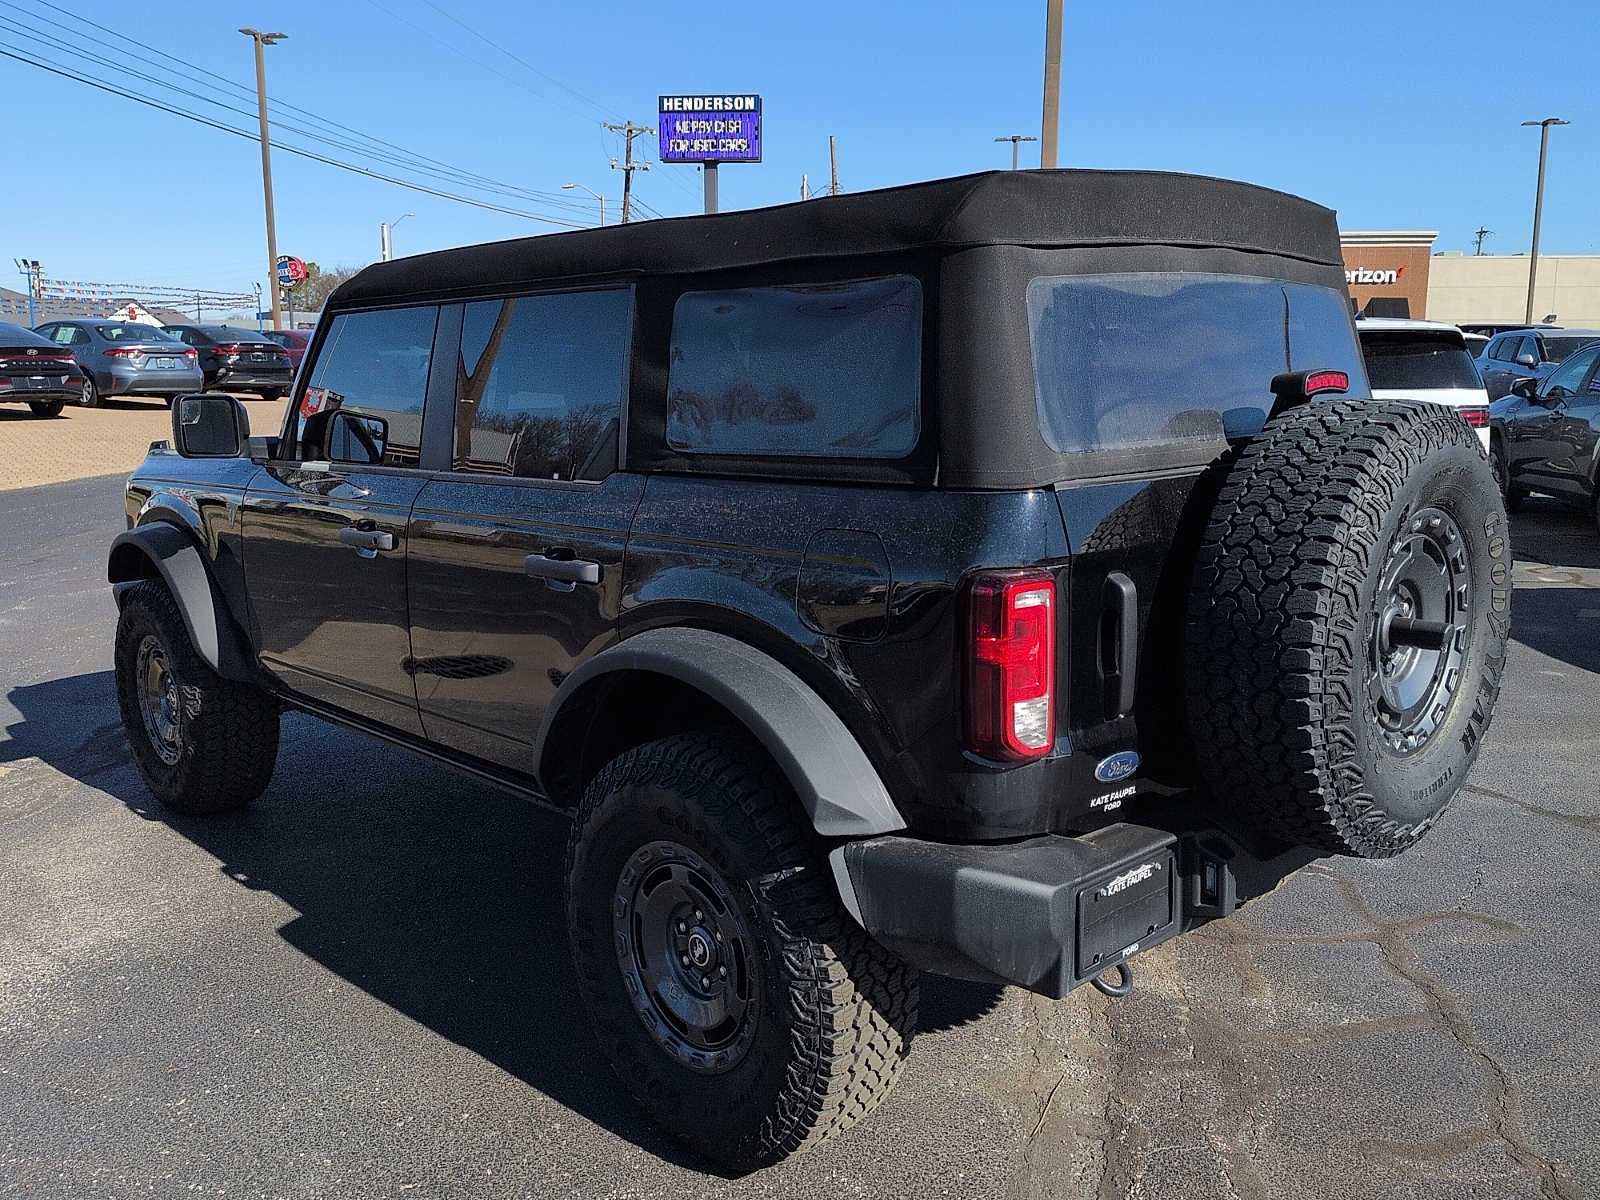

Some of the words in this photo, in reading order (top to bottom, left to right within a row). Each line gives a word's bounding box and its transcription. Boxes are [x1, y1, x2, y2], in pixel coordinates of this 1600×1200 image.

[663, 96, 755, 111] HENDERSON
[691, 120, 712, 133] PAY
[669, 139, 688, 152] FOR
[1090, 794, 1110, 808] KATE
[1109, 785, 1136, 801] FAUPEL
[1103, 800, 1121, 812] FORD
[1107, 880, 1127, 897] KATE
[1126, 869, 1153, 888] FAUPEL
[1122, 943, 1139, 959] FORD
